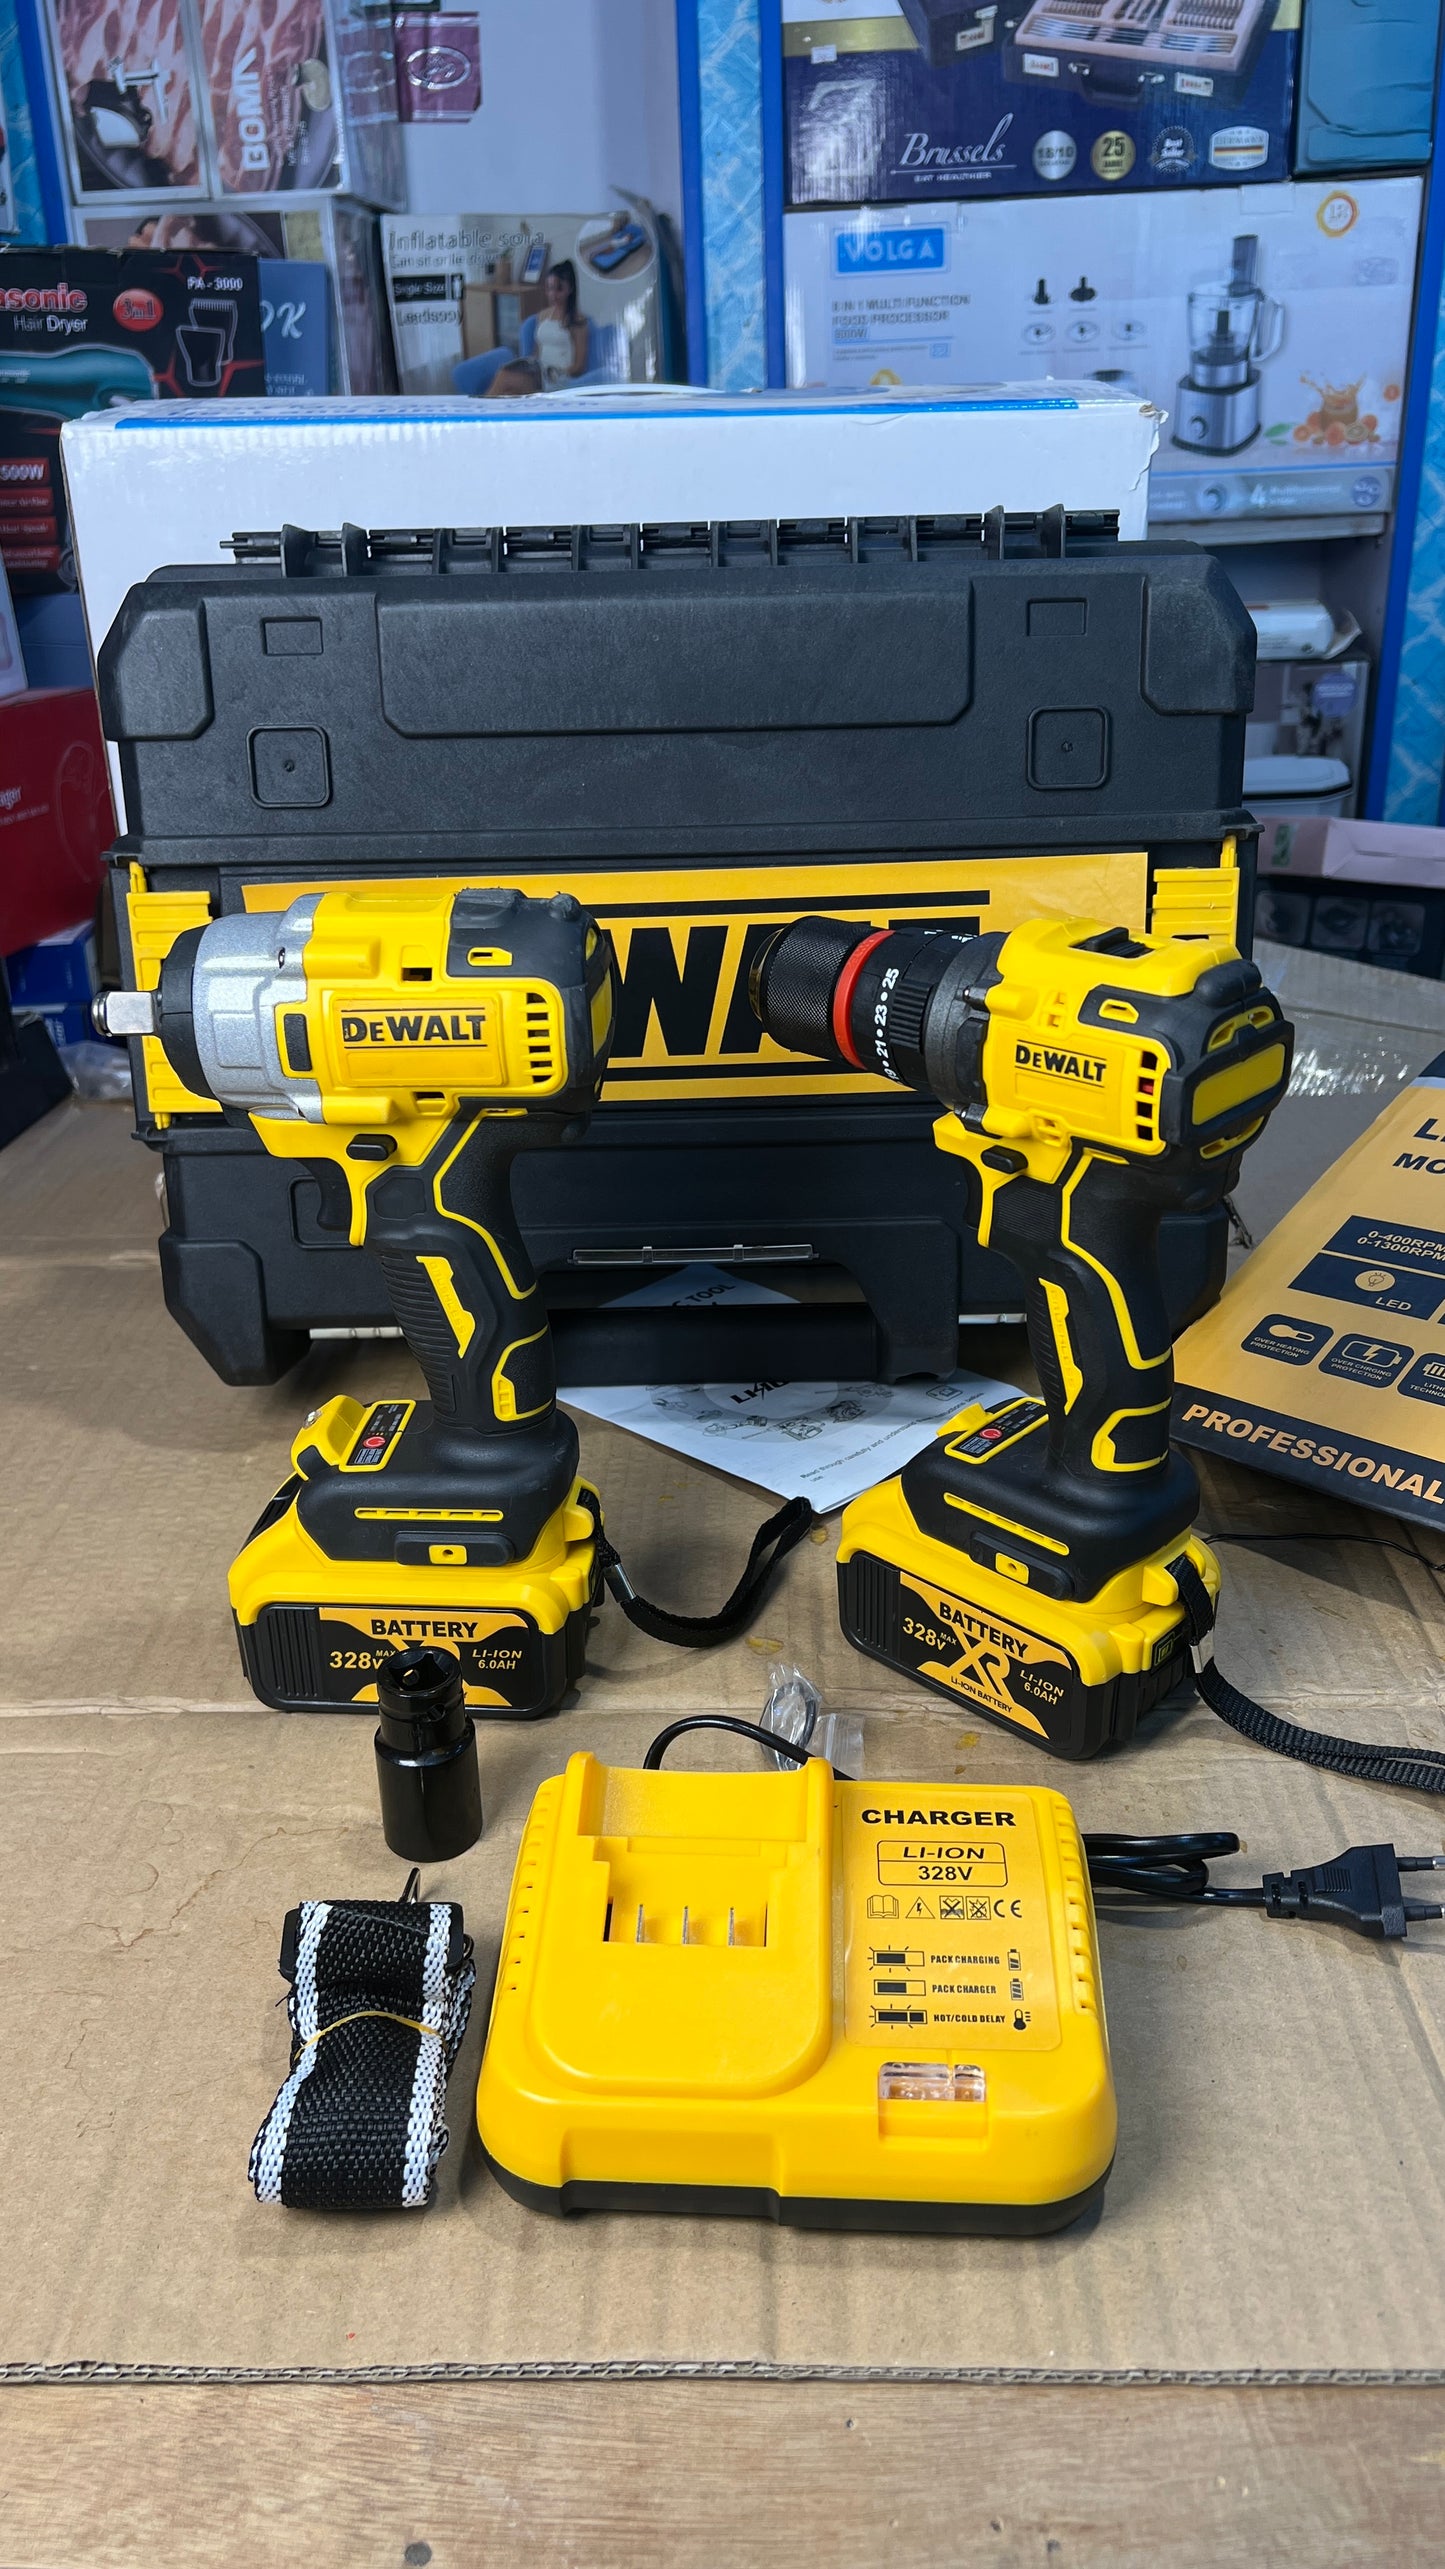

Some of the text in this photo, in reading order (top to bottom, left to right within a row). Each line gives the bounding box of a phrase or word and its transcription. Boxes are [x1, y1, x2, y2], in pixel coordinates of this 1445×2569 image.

[900, 112, 1014, 166] Brussels
[1103, 136, 1126, 157] 25
[389, 229, 492, 251] Inflatable
[843, 239, 936, 263] VOLGA
[14, 315, 88, 335] Hair Dryer
[882, 968, 900, 990] 25
[874, 1004, 888, 1027] 23
[874, 1040, 889, 1059] 21
[1413, 1118, 1445, 1143] L
[685, 1284, 736, 1303] TOOL
[1375, 1296, 1412, 1312] LED
[1250, 1341, 1300, 1358] PROTECTION
[1254, 1336, 1310, 1355] OVER HEATING
[1330, 1363, 1383, 1381] PROTECTION
[1331, 1357, 1354, 1368] OVER
[800, 1468, 817, 1480] Read
[818, 1458, 844, 1473] through
[845, 1445, 872, 1461] carefully
[871, 1438, 884, 1448] and
[883, 1420, 916, 1442] understand
[1181, 1403, 1445, 1505] PROFESSIONAL
[371, 1619, 478, 1639] BATTERY
[939, 1601, 1029, 1659] BATTERY
[939, 1632, 958, 1646] MAX
[472, 1649, 522, 1659] LI-ION
[478, 1659, 517, 1670] 6.0AH
[1019, 1669, 1065, 1698] LI-ION
[951, 1676, 1013, 1713] LI-ION BATTERY
[1024, 1681, 1058, 1706] 6.0AH
[861, 1809, 1017, 1827] CHARGER
[903, 1846, 985, 1860] LI-ION
[918, 1865, 973, 1881] 328V
[930, 1955, 1000, 1965] PACK CHARGING
[932, 1984, 997, 1994] PACK CHARGER
[980, 2015, 1006, 2024] DELAY
